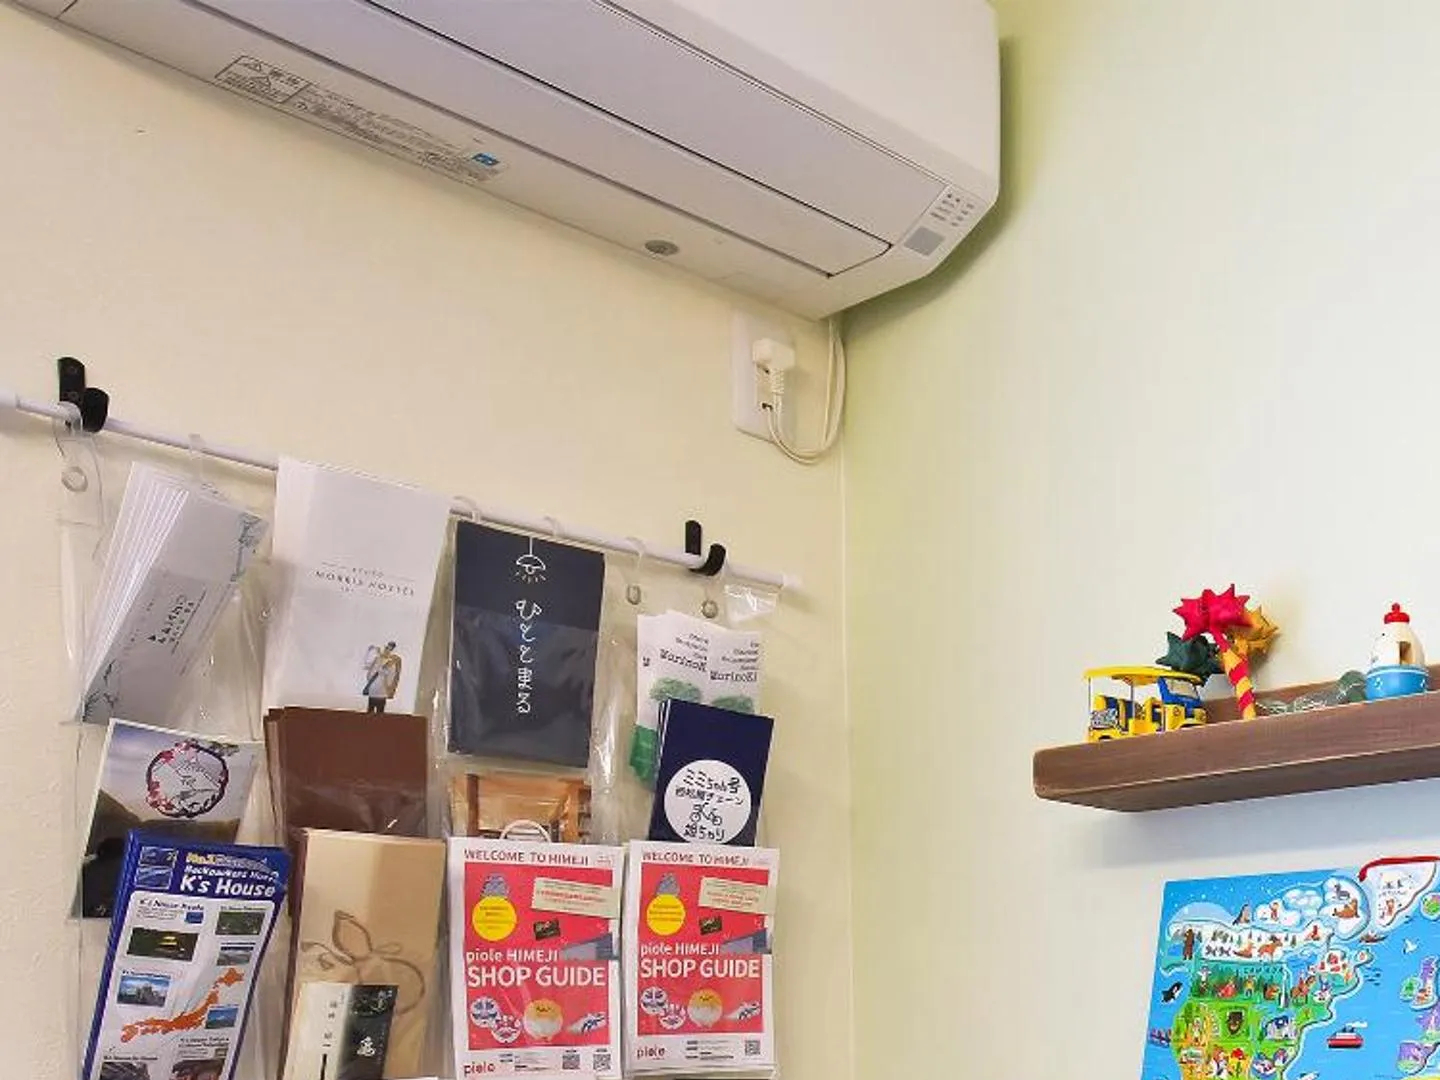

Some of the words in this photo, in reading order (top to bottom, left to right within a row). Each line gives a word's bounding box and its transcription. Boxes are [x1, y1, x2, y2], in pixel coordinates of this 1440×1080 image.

[464, 849, 524, 863] WELCOME
[531, 852, 546, 863] TO
[549, 854, 589, 866] HIMEJI
[643, 852, 694, 863] WELCOME
[699, 854, 712, 864] TO
[714, 856, 749, 865] HIMEJI
[180, 874, 211, 893] K's
[215, 877, 276, 897] House
[507, 949, 558, 962] HIMEJI
[675, 942, 719, 955] HIMEJI
[468, 966, 532, 987] SHOP
[536, 966, 605, 987] GUIDE
[640, 959, 696, 978] SHOP
[700, 959, 760, 978] GUIDE
